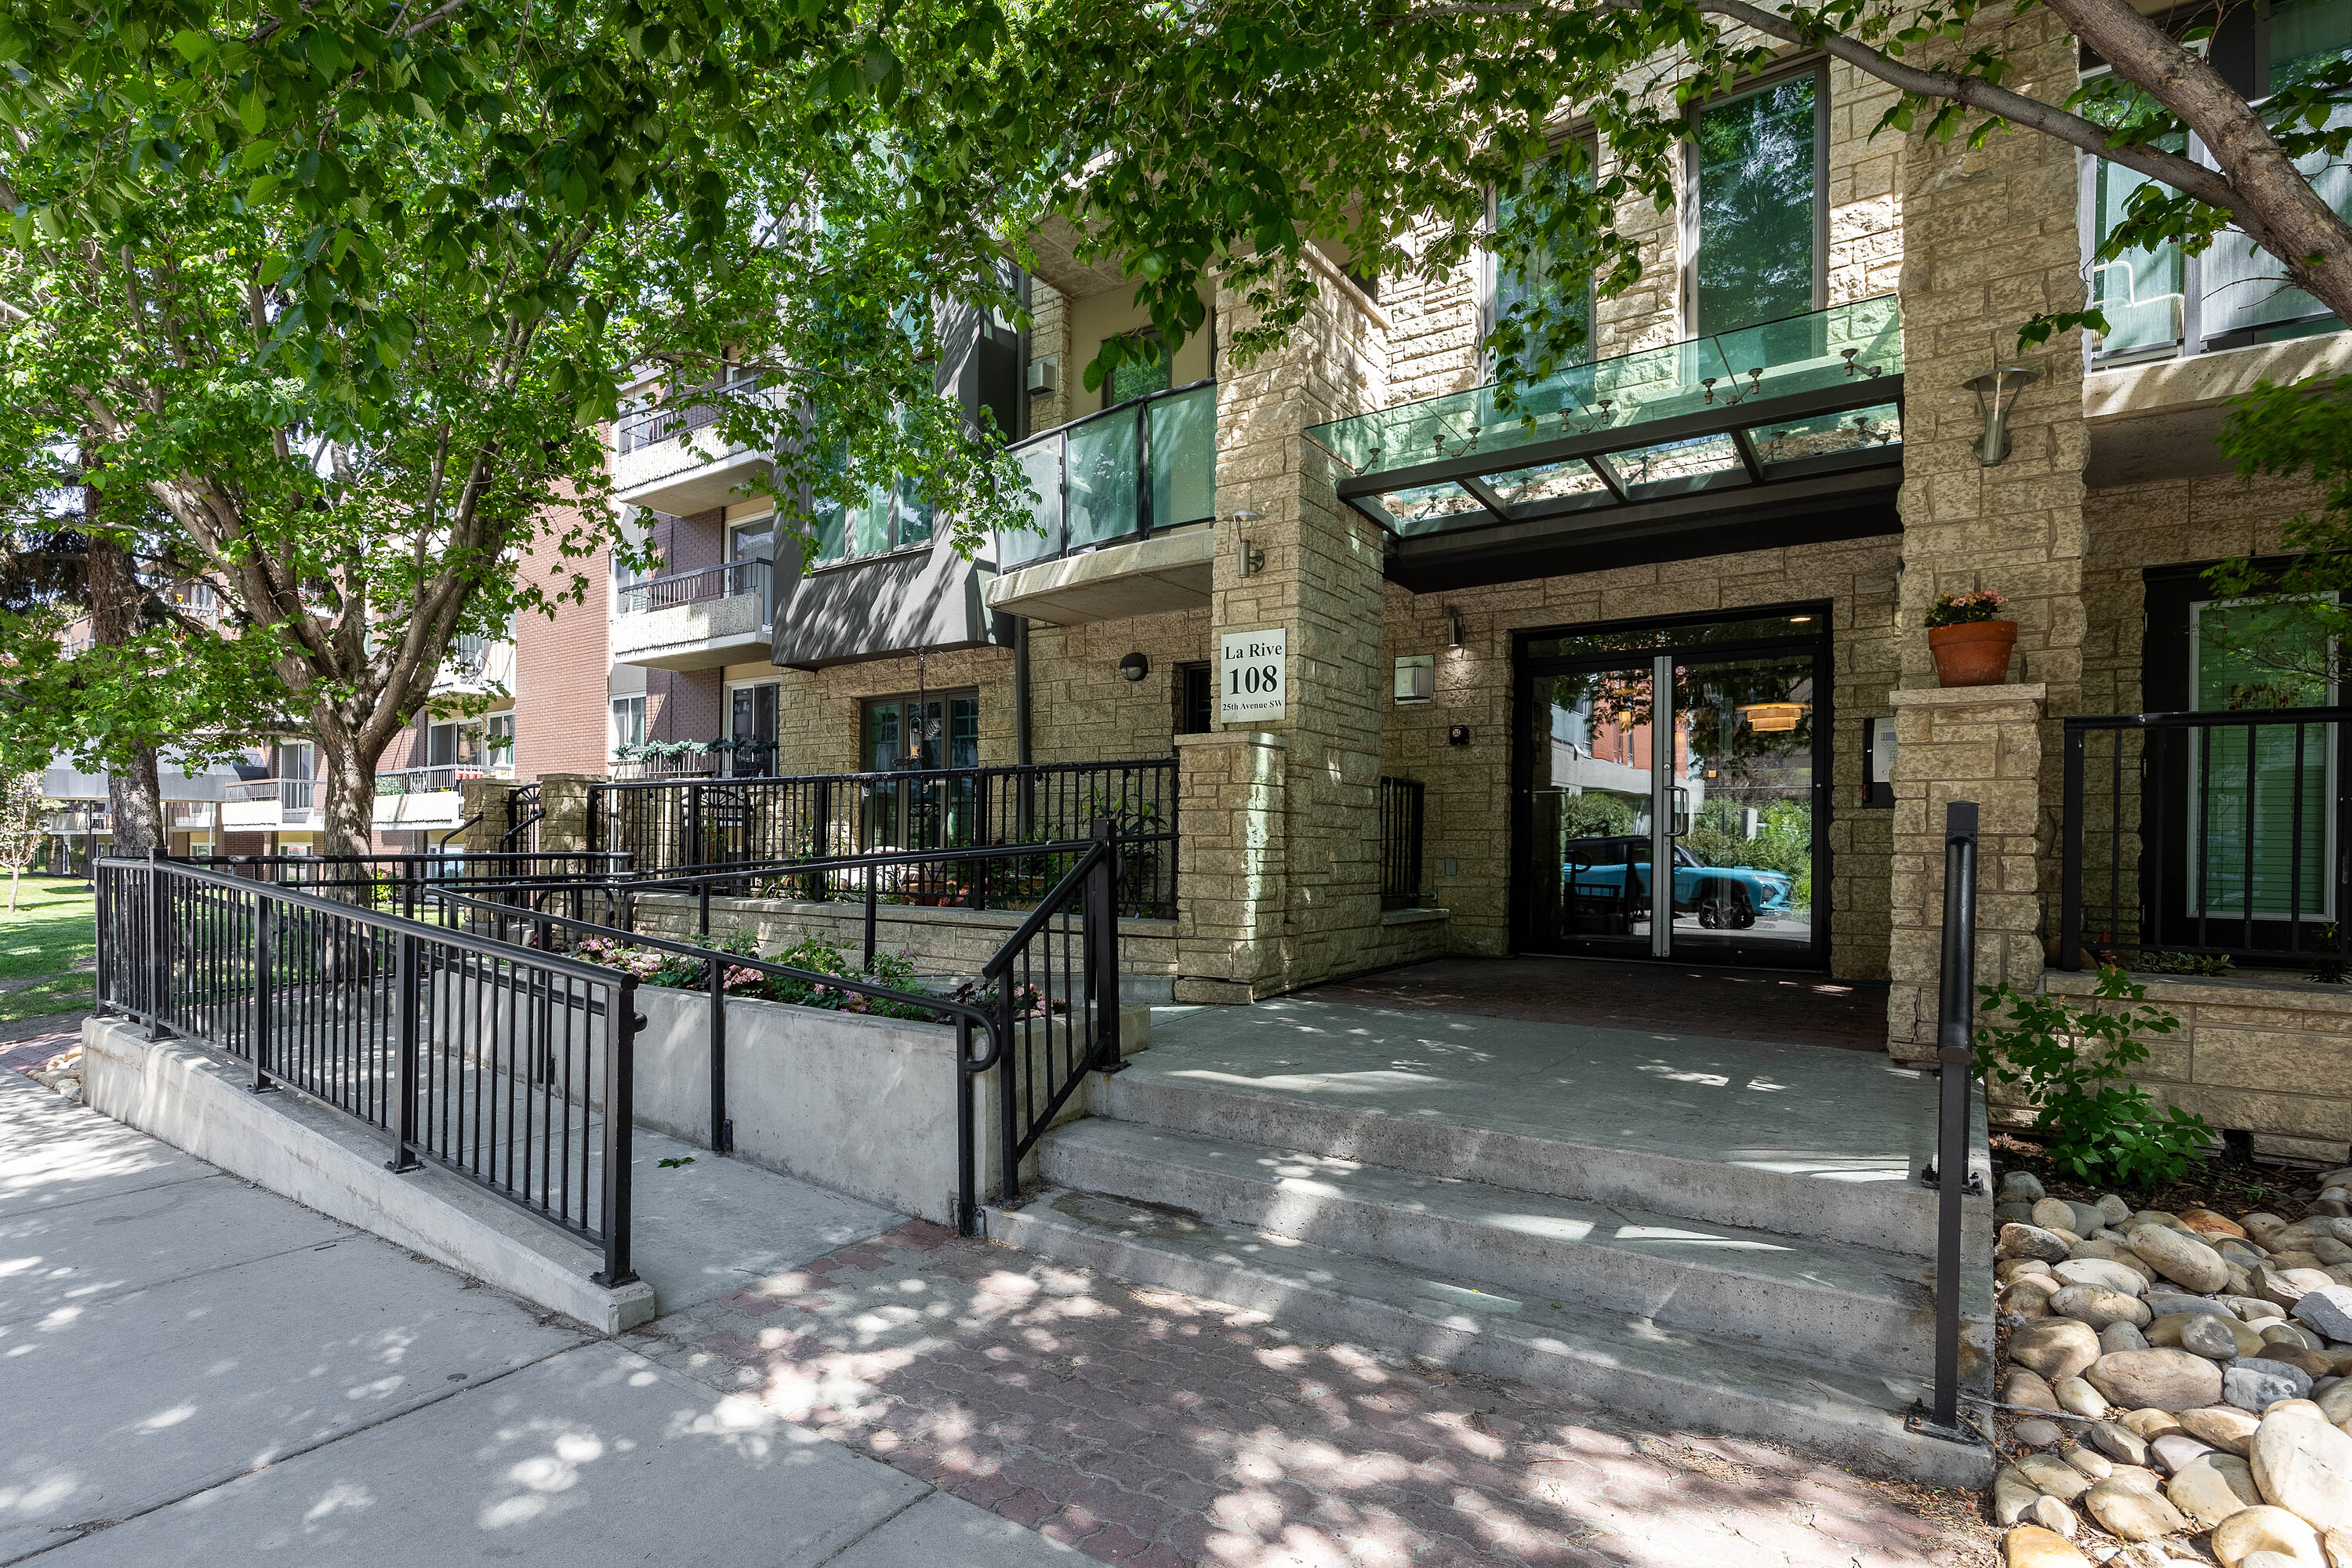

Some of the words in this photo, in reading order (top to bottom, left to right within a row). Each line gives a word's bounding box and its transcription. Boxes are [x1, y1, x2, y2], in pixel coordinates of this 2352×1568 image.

[1225, 646, 1243, 659] La
[1249, 643, 1283, 658] Rive
[1229, 665, 1277, 695] 108
[1269, 699, 1283, 708] SW
